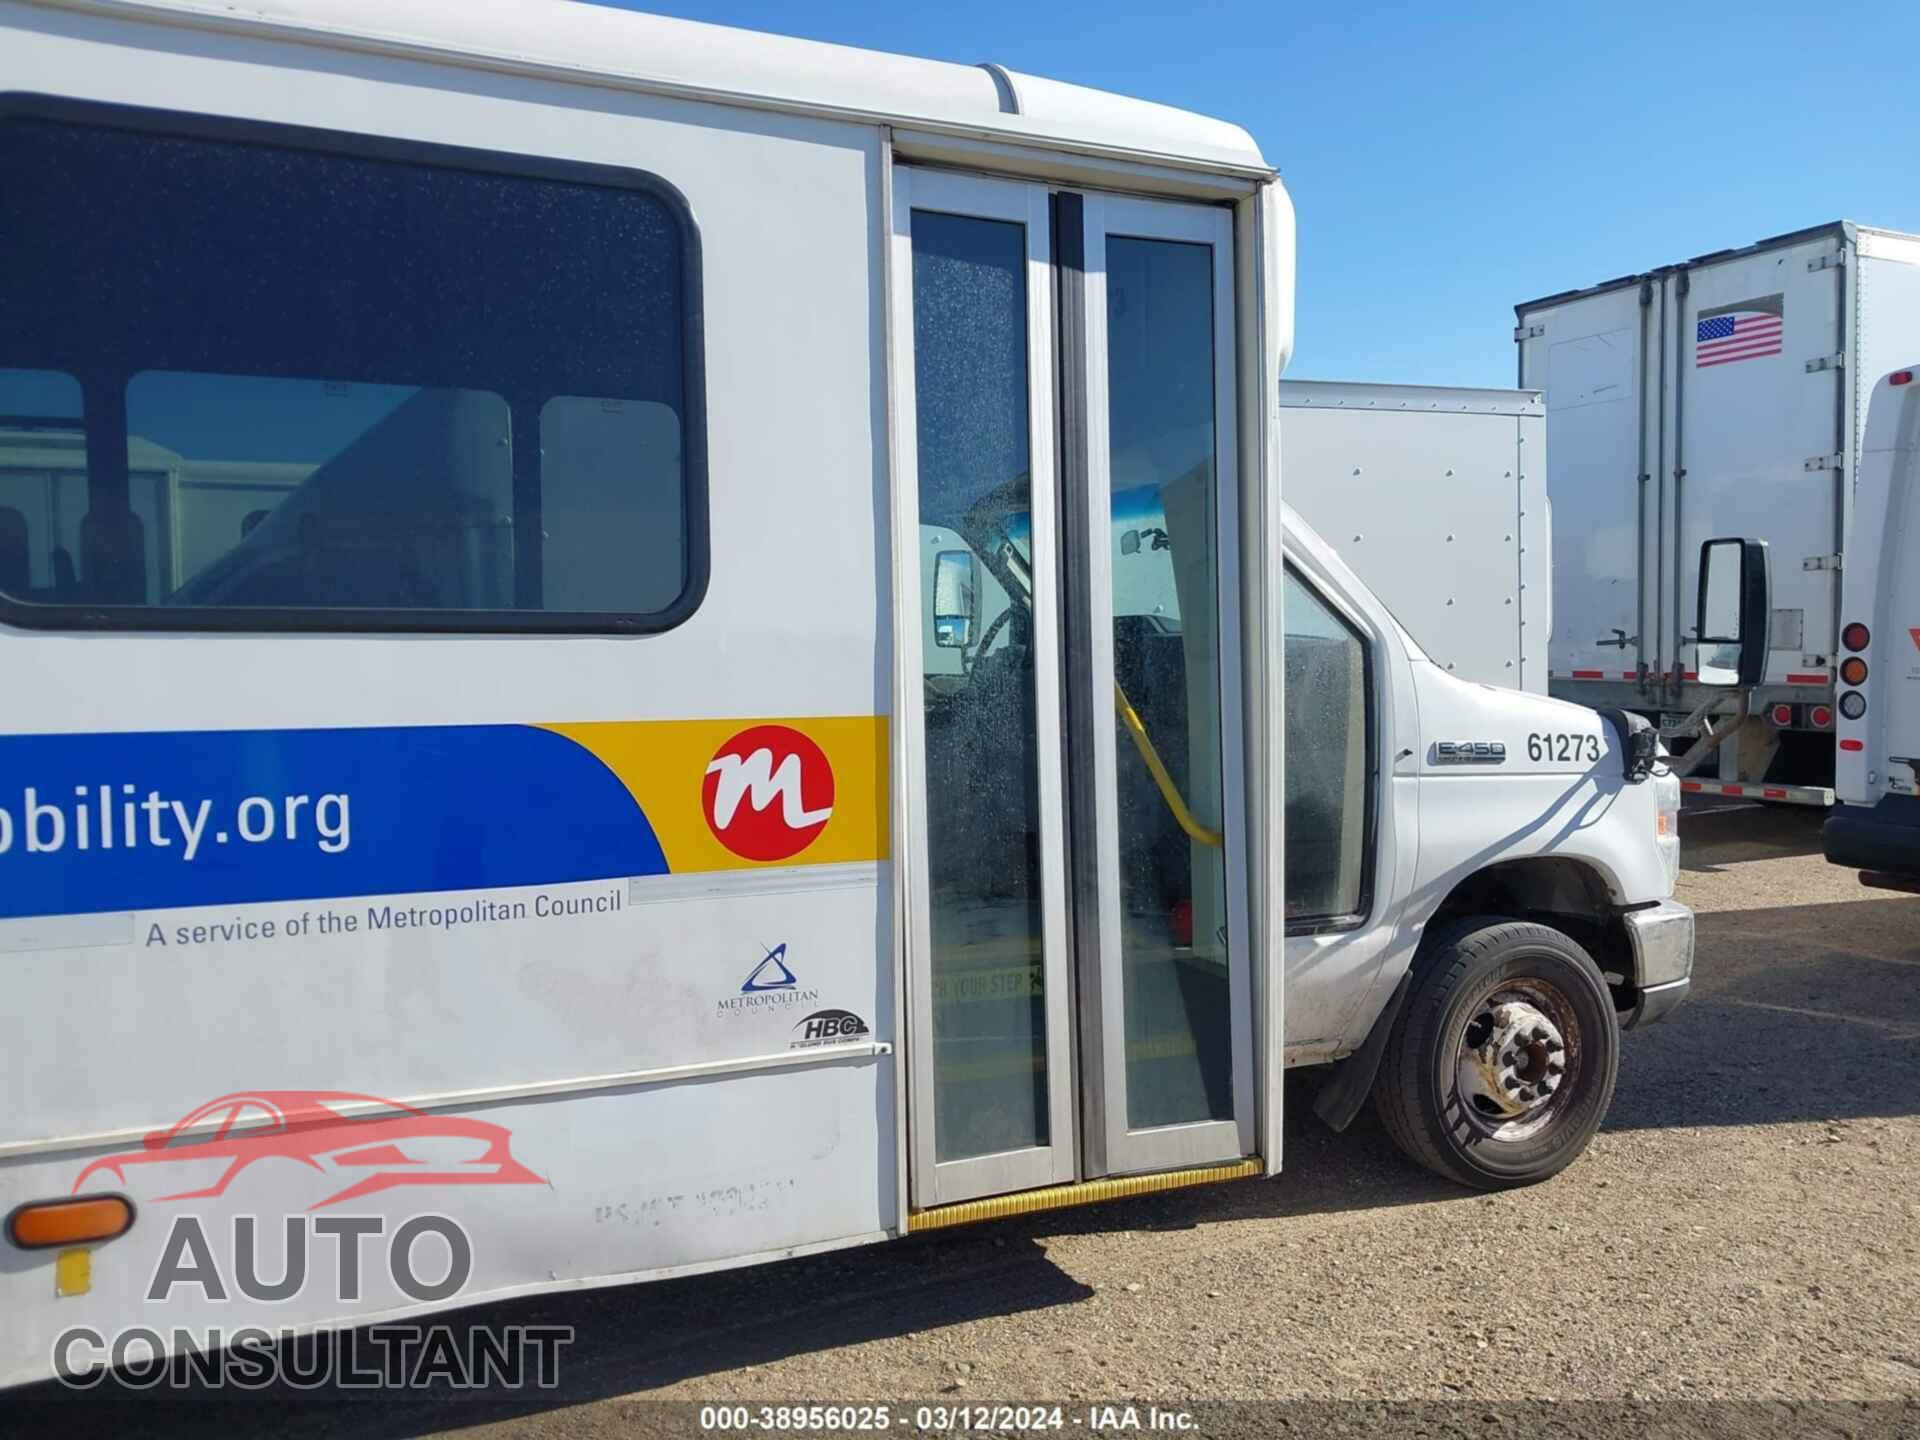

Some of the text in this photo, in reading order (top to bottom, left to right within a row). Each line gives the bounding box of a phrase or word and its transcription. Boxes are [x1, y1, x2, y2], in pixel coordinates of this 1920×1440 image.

[1527, 732, 1600, 763] 61273
[146, 888, 622, 948] A service of the Metropolitan Council
[717, 989, 819, 1010] METROPOLITAN
